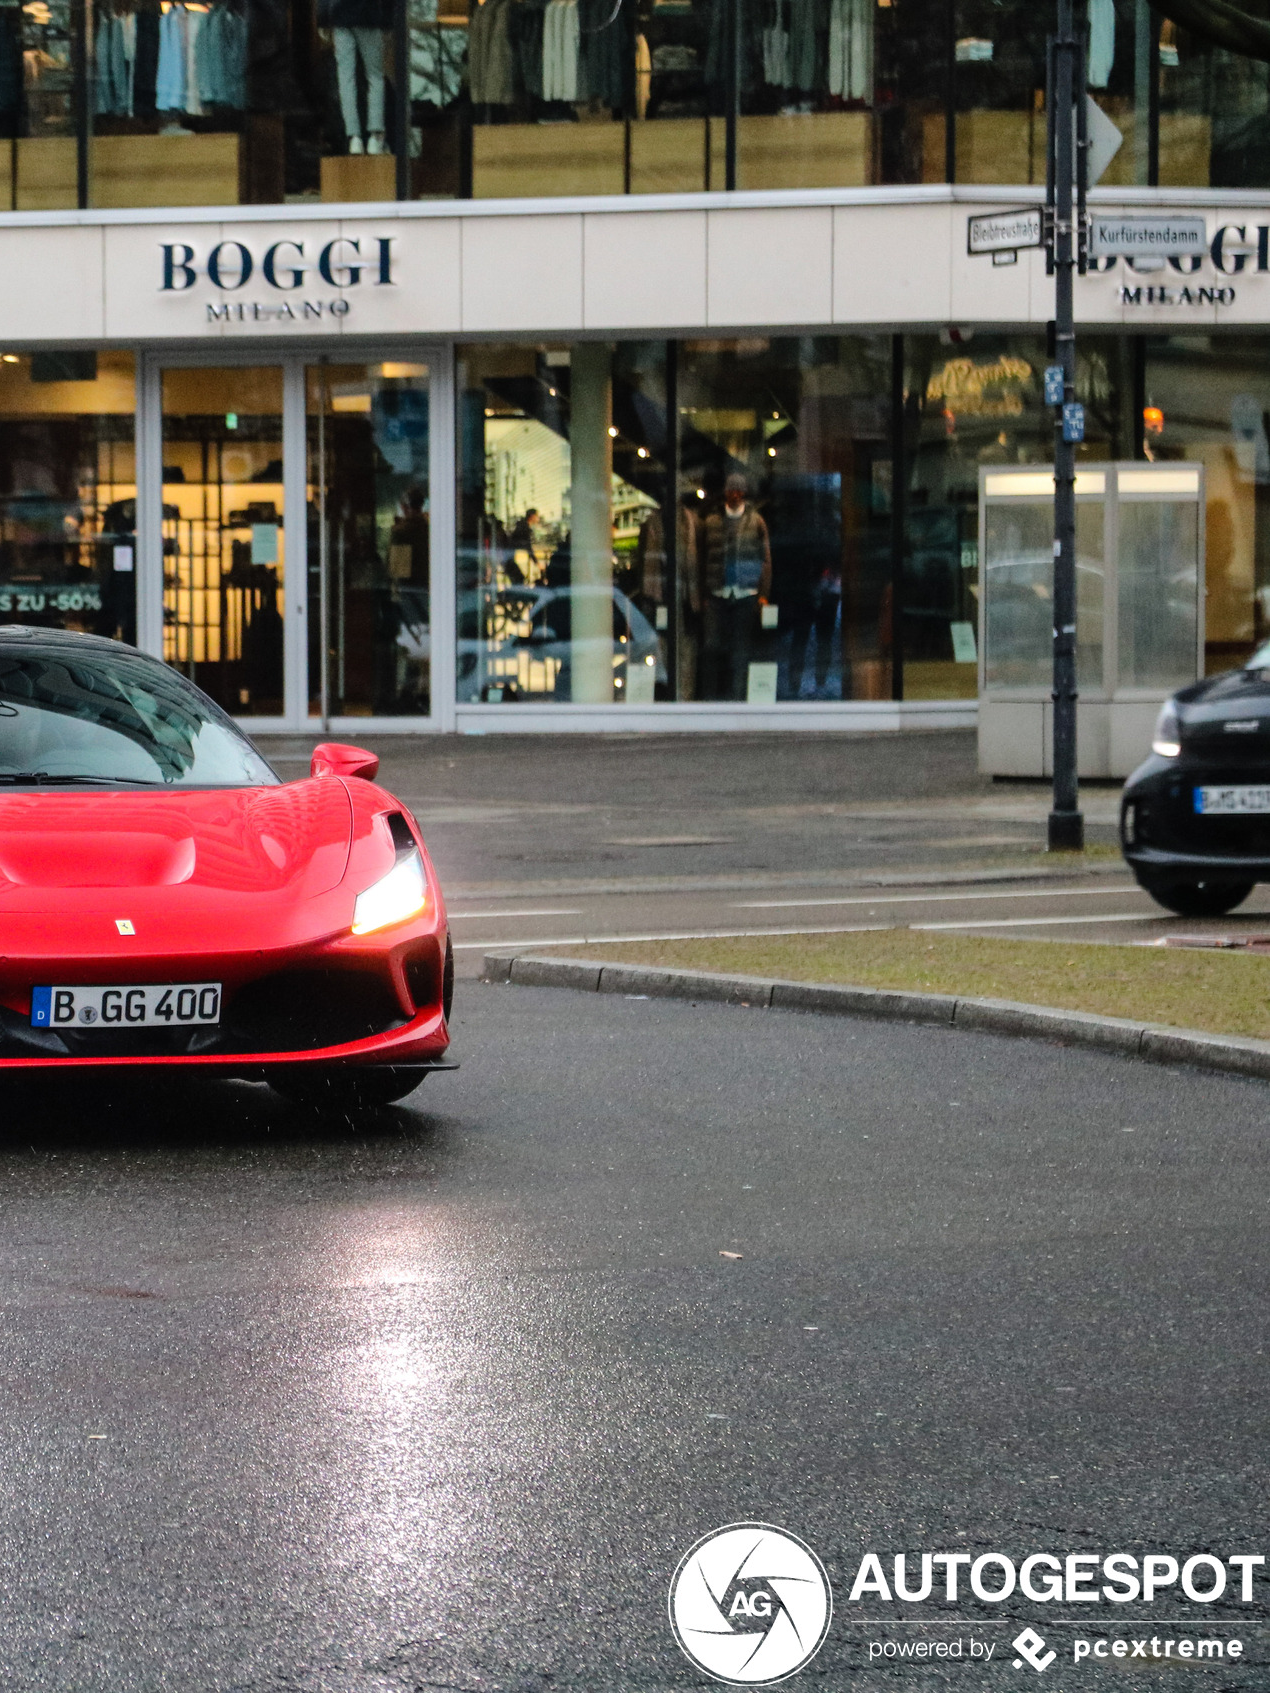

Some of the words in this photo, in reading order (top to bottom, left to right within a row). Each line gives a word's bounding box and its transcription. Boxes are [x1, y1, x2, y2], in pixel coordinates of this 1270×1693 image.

[972, 217, 1039, 242] Bleibtreustraße
[1099, 225, 1199, 244] Kurfürstendamm
[158, 236, 397, 291] BOGGI
[1121, 286, 1236, 306] MILANO
[207, 299, 351, 323] MILANO
[16, 594, 46, 611] ZU
[37, 1011, 45, 1020] D
[54, 991, 75, 1023] B
[101, 990, 146, 1023] GG
[154, 988, 219, 1022] 400
